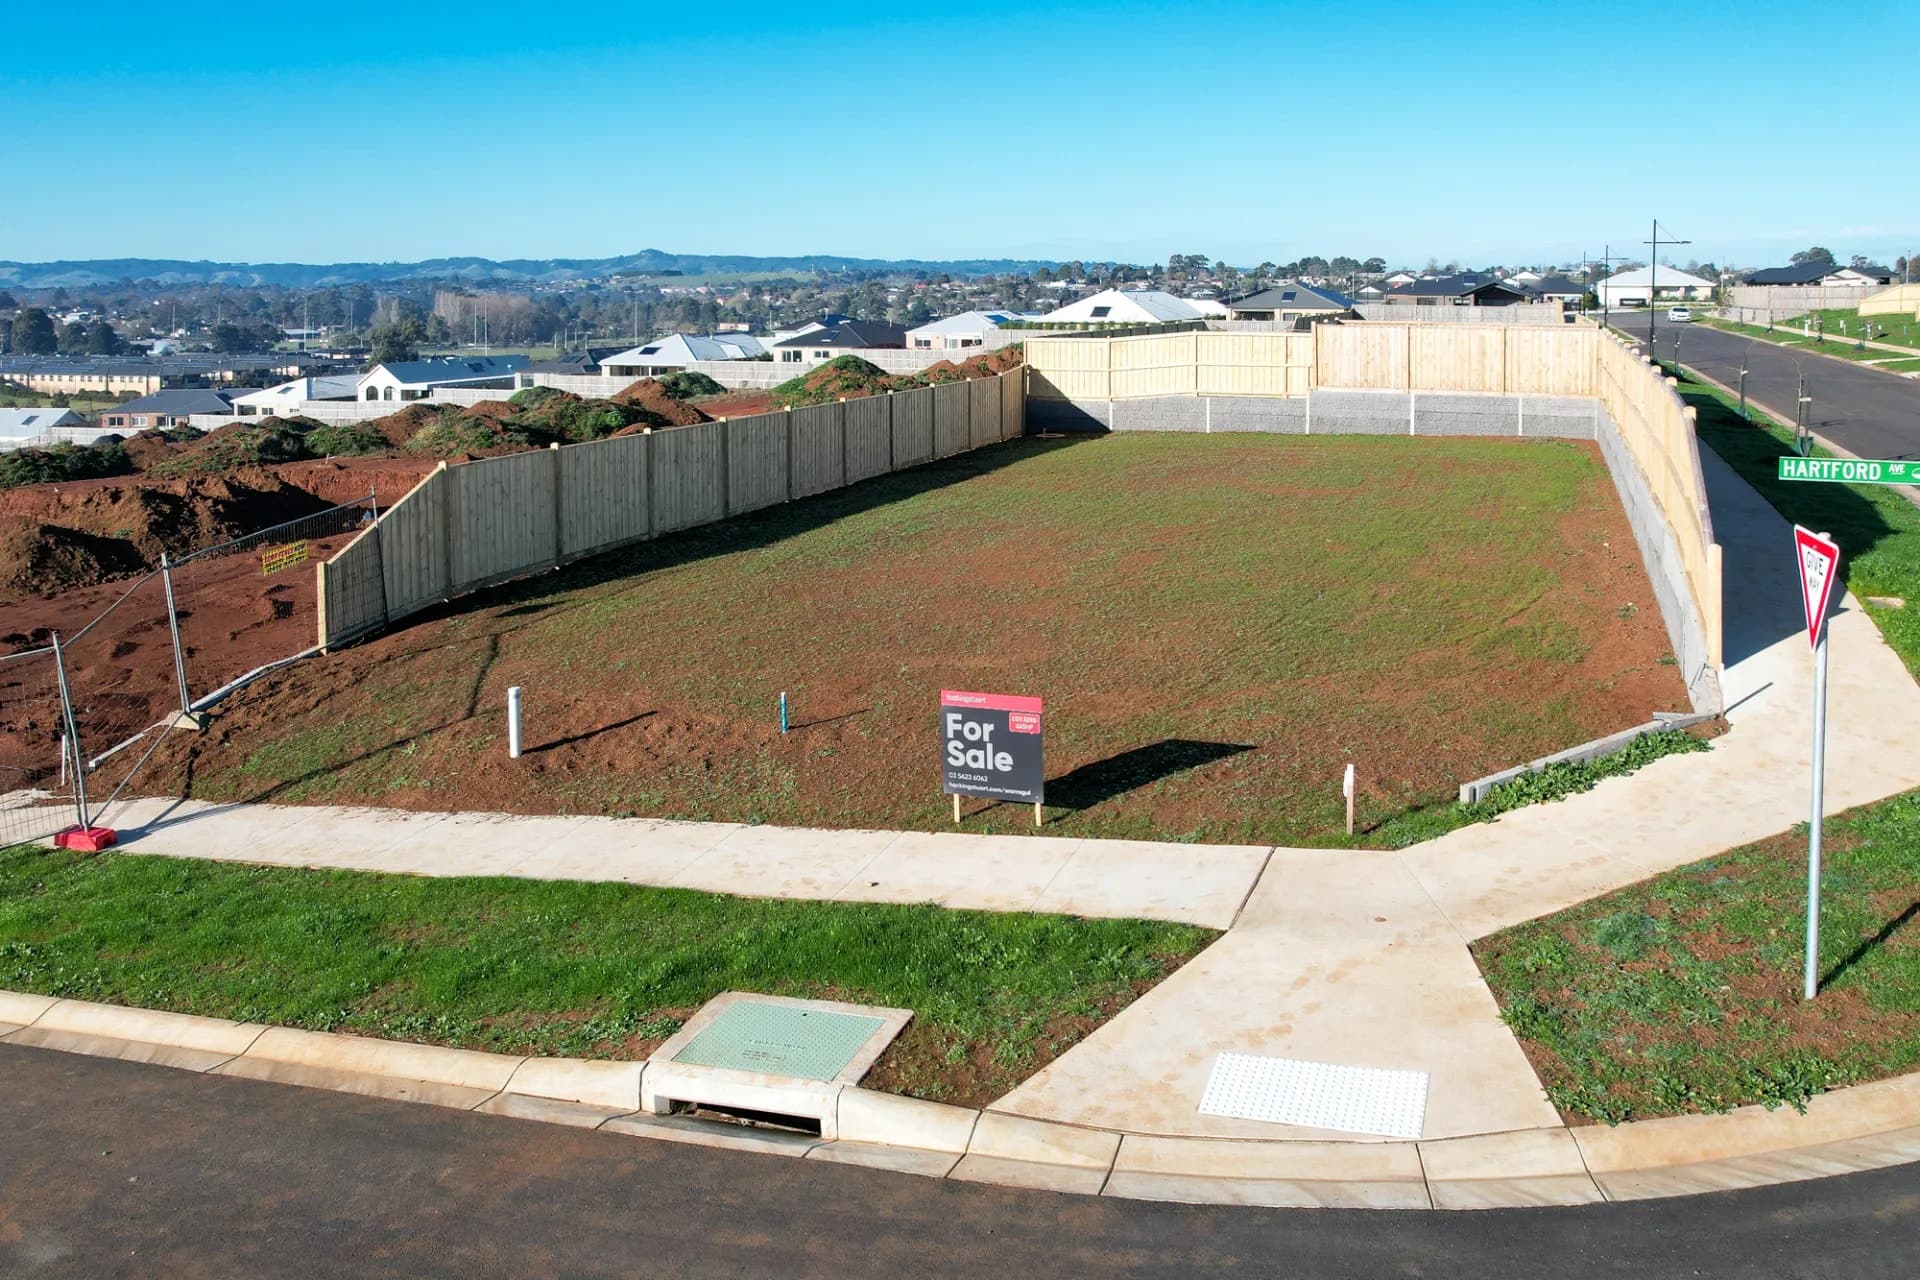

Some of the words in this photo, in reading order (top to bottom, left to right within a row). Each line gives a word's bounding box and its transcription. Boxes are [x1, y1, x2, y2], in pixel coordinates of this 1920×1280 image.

[1783, 460, 1881, 480] HARTFORD
[1889, 464, 1906, 473] AVE
[1807, 551, 1824, 576] GIVE
[946, 713, 994, 742] For
[947, 740, 1013, 771] Sale
[973, 774, 988, 782] 6062
